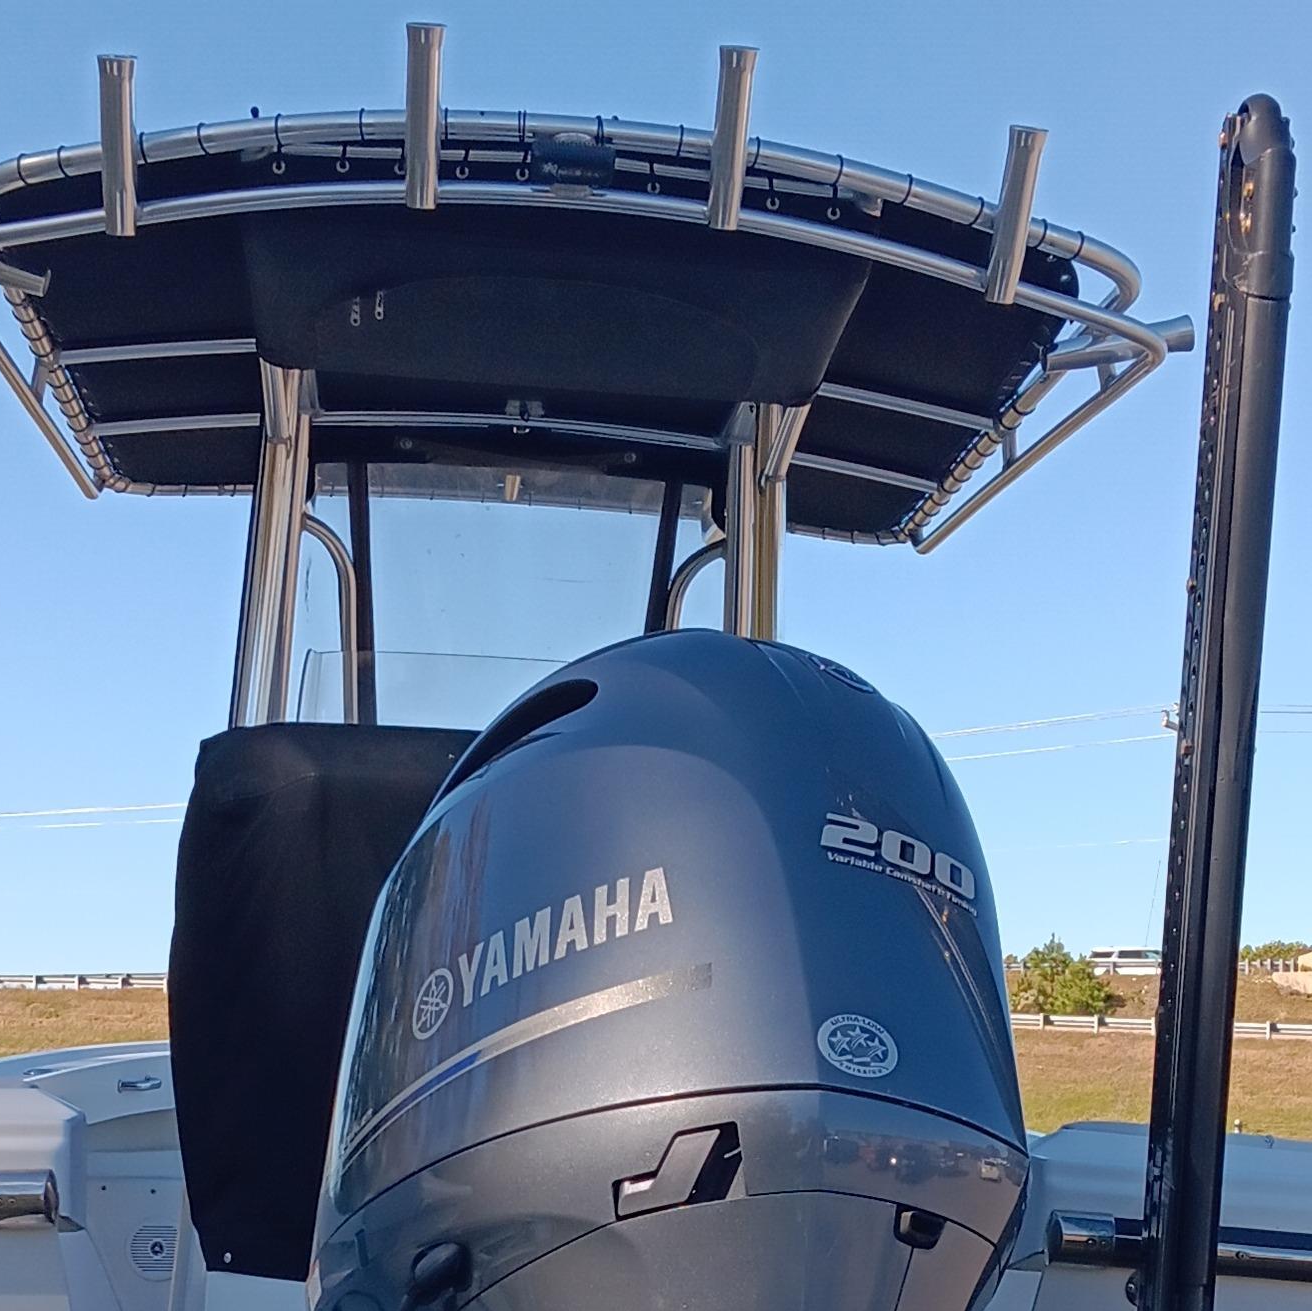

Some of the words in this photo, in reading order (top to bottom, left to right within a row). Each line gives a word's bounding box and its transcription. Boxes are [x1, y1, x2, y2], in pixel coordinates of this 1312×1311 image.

[820, 812, 976, 900] 200
[826, 850, 883, 872] Variable
[885, 866, 945, 896] Camshaft
[946, 890, 979, 918] Timing
[457, 866, 674, 1008] YAMAHA
